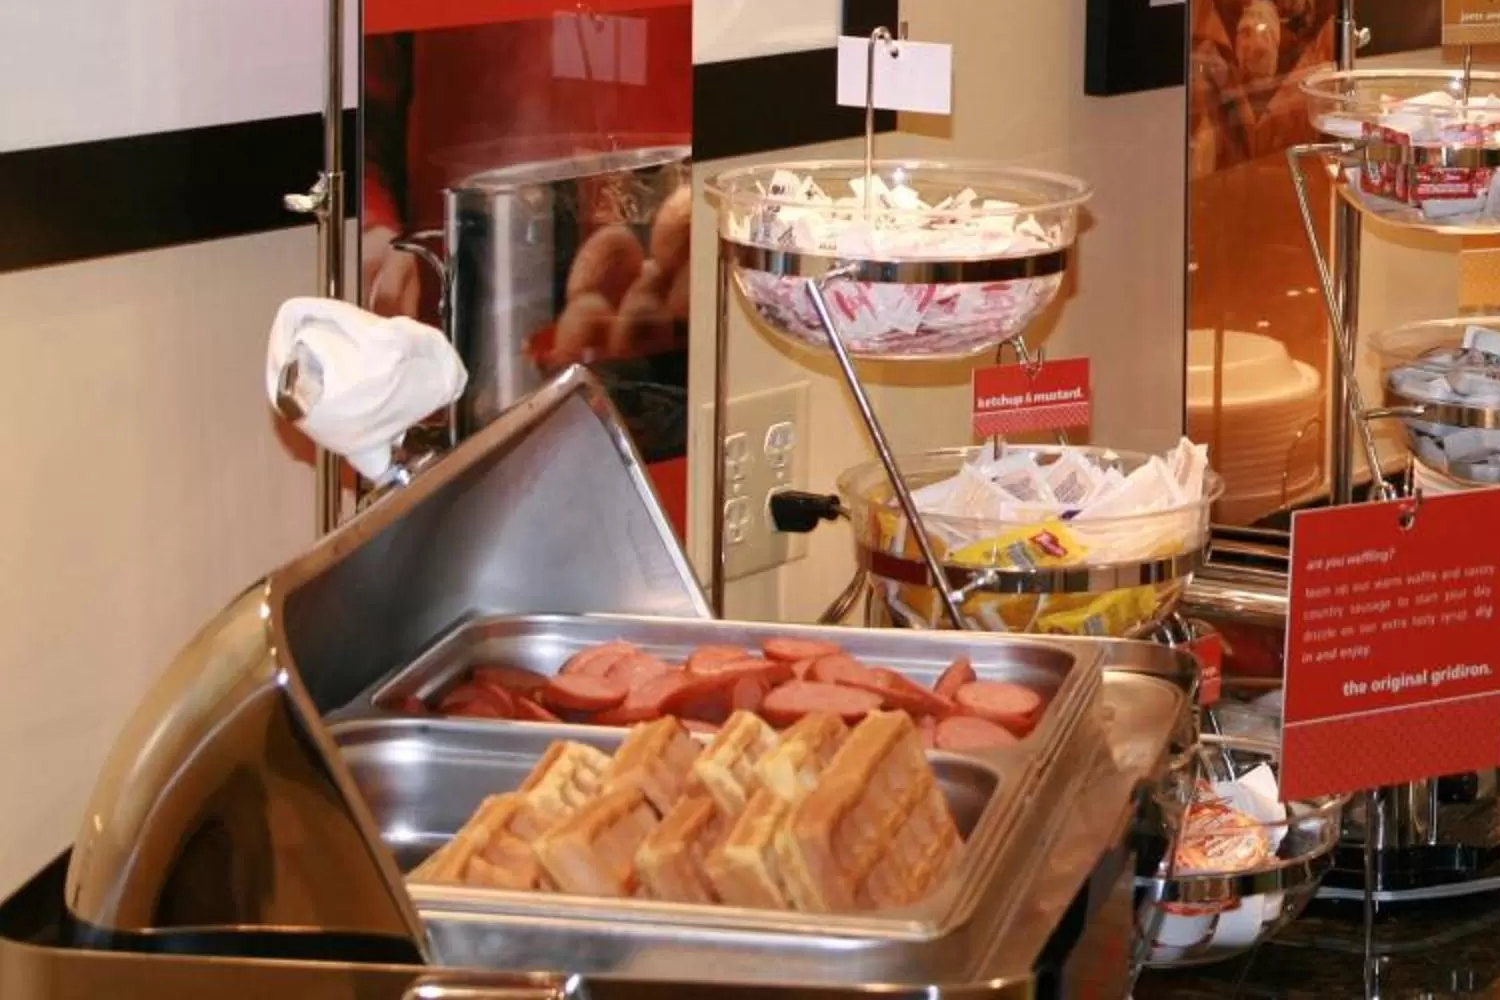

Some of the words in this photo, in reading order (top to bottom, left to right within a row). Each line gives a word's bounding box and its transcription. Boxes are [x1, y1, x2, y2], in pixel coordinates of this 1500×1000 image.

[976, 393, 1023, 408] ketchup
[1325, 556, 1344, 571] you
[1315, 647, 1337, 662] and
[1343, 679, 1367, 697] the
[1371, 668, 1428, 694] original
[1431, 662, 1493, 687] gridiron.
